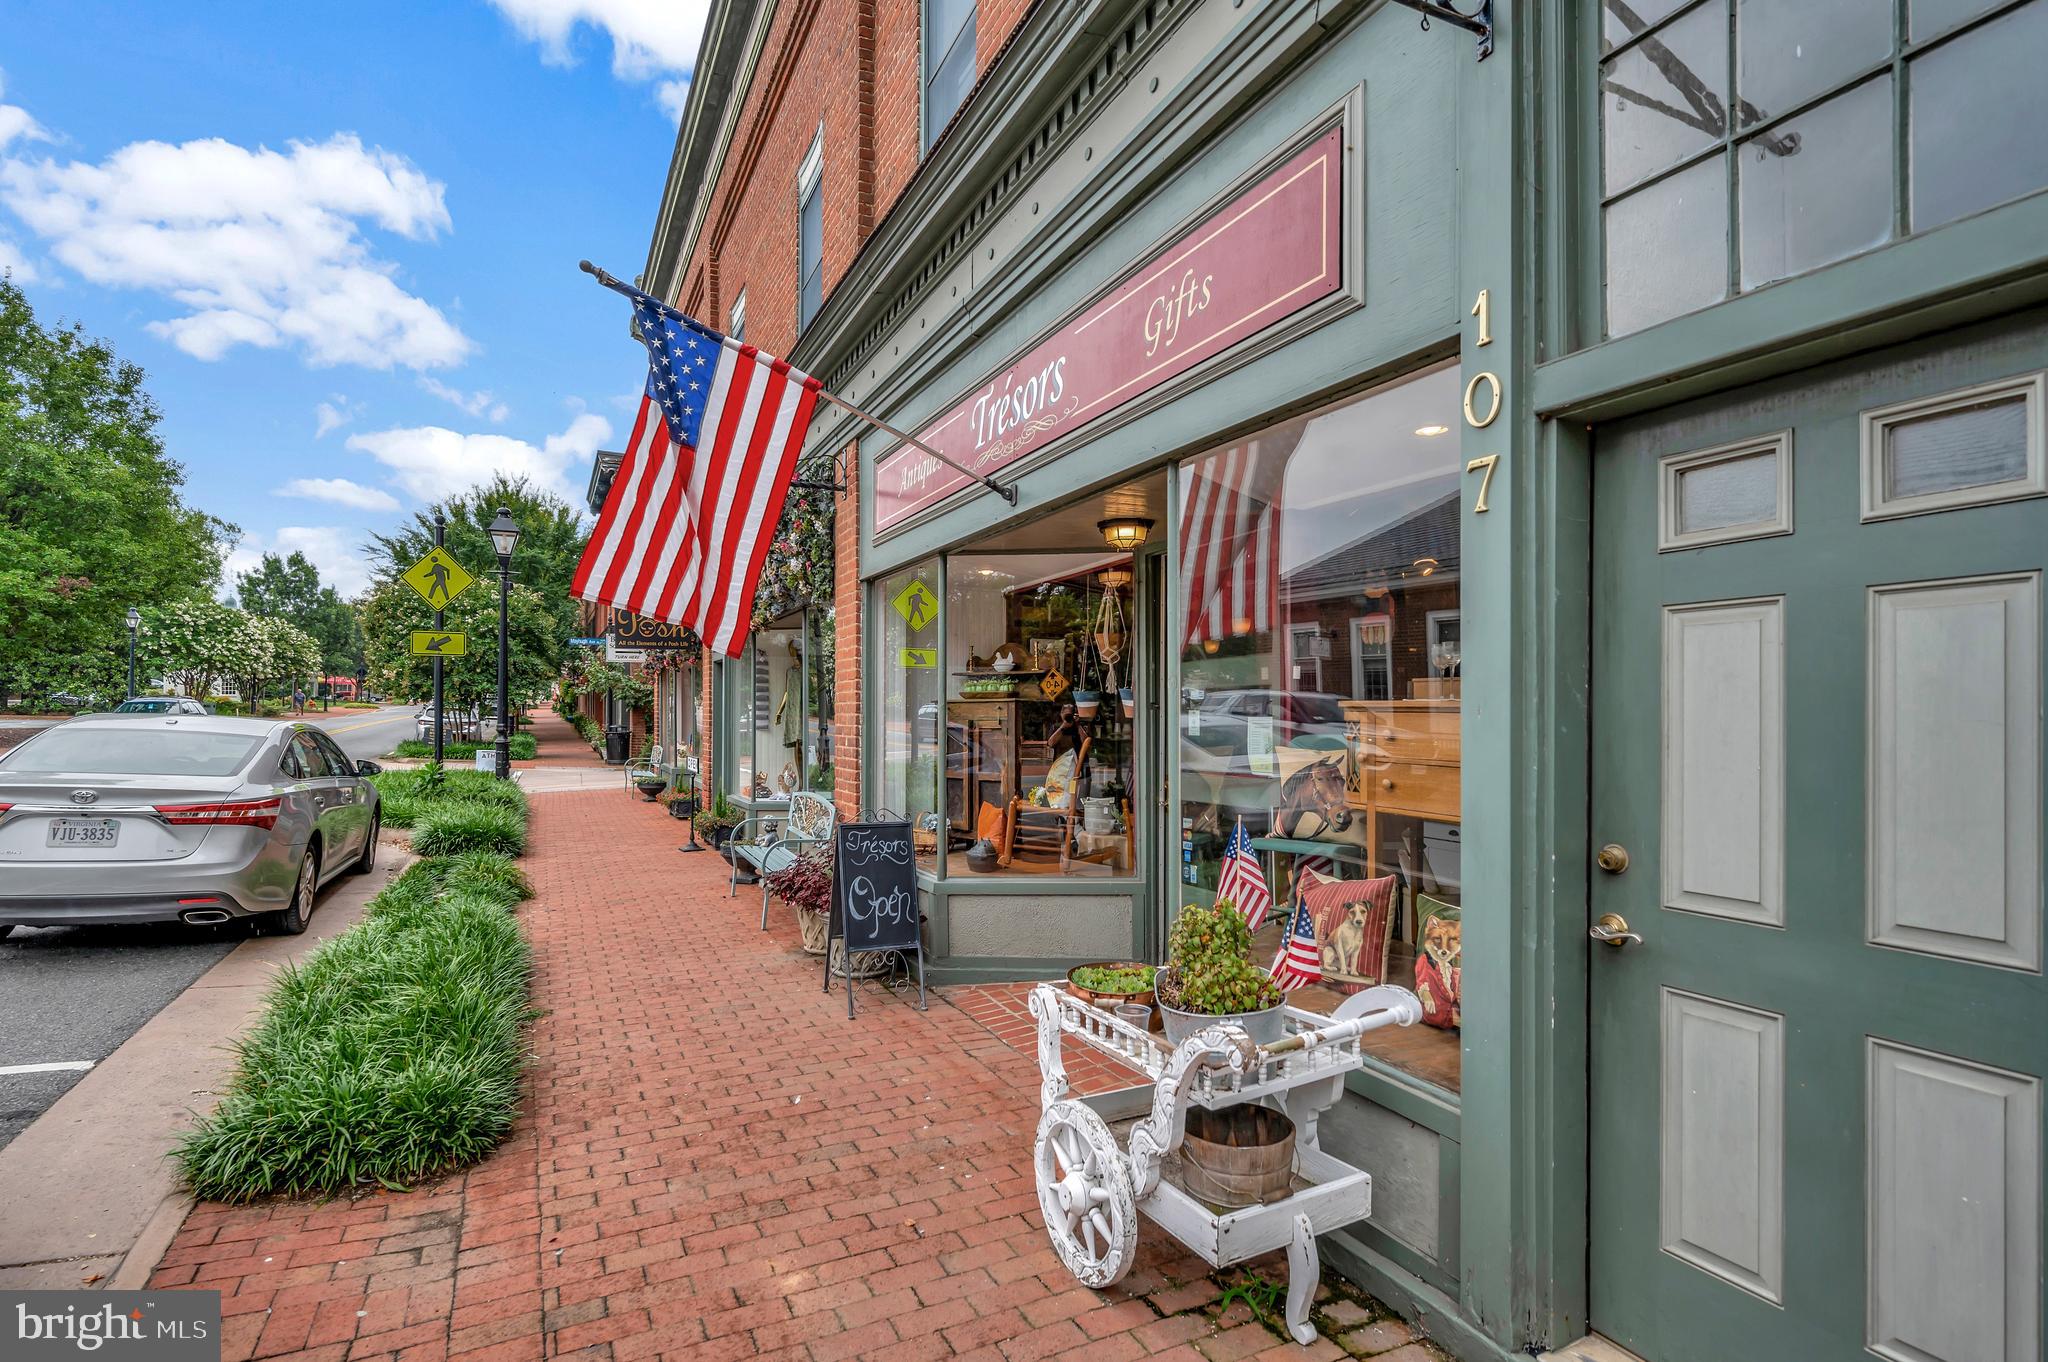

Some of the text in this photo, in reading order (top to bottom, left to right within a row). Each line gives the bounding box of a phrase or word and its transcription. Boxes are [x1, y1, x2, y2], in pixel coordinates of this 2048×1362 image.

[970, 356, 1067, 451] Trésors
[1144, 268, 1213, 357] Gifts
[1463, 288, 1503, 514] 107
[52, 827, 115, 841] VJU-3835
[68, 820, 102, 828] VIRGINIA
[845, 829, 909, 856] Trésors
[848, 875, 915, 939] Open
